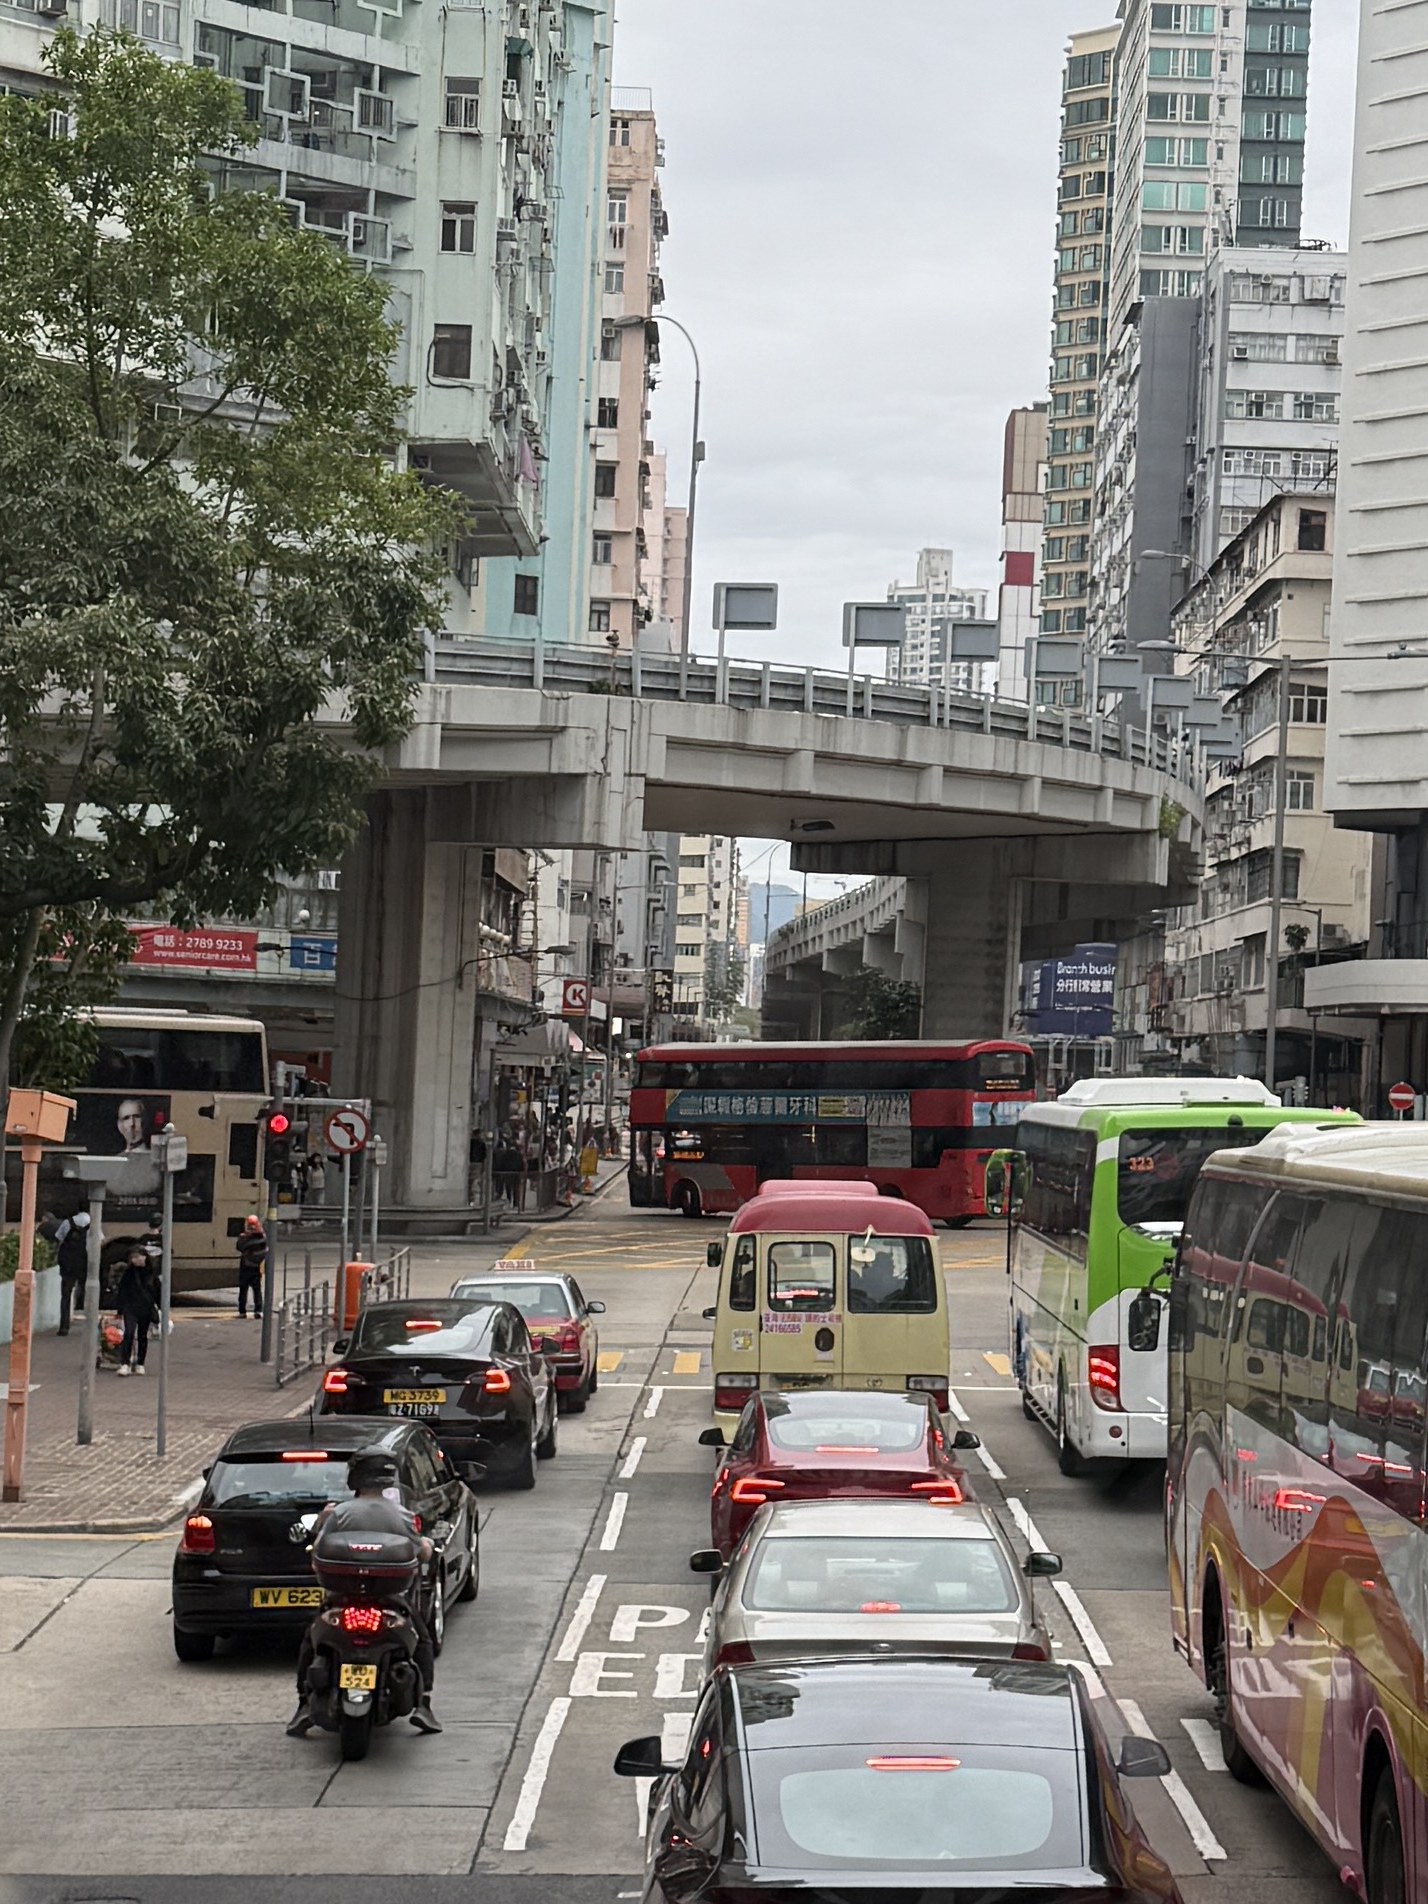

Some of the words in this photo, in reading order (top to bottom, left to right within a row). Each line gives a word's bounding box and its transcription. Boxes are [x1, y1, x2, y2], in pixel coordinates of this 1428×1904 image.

[186, 937, 213, 950] 2789
[216, 938, 243, 951] 9233
[288, 1590, 322, 1604] 623
